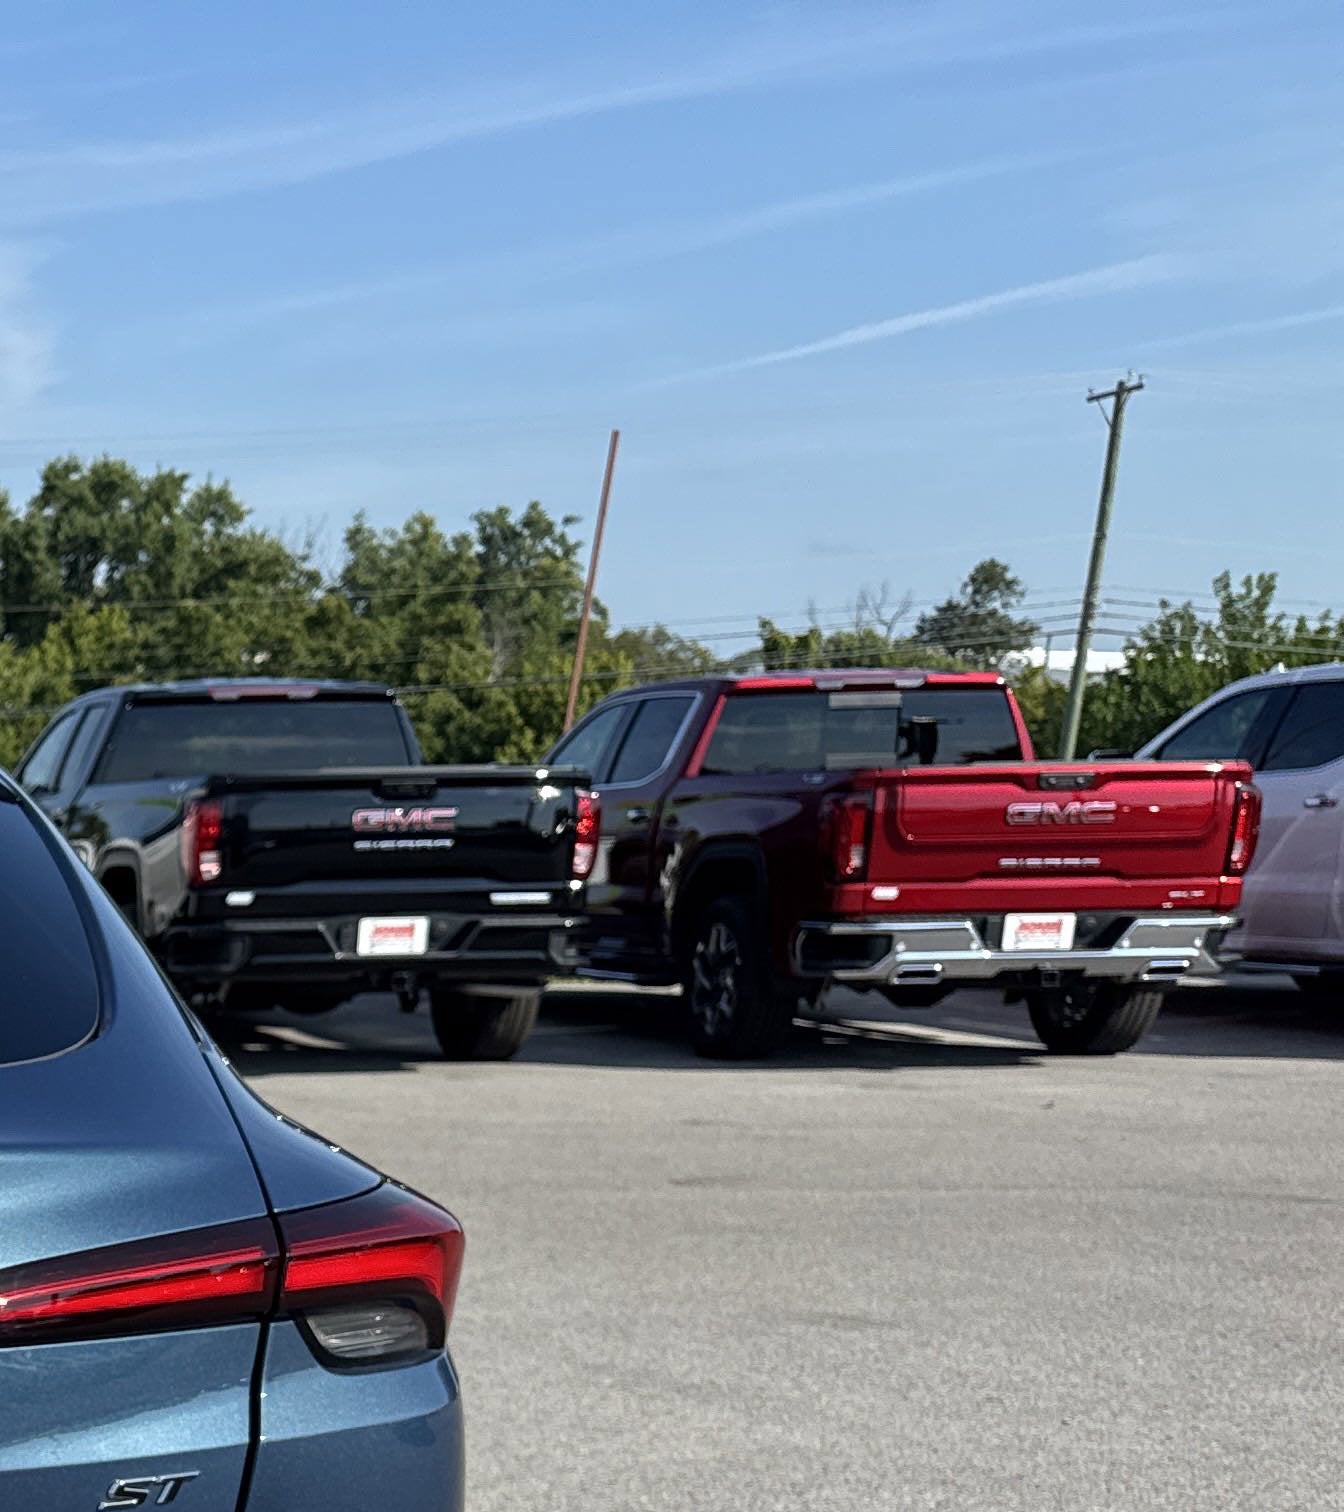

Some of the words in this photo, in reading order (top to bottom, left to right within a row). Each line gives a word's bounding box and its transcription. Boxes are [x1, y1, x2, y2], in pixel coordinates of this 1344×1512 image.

[352, 807, 460, 832] GMC
[1006, 801, 1117, 825] GMC
[97, 1470, 201, 1512] ST
